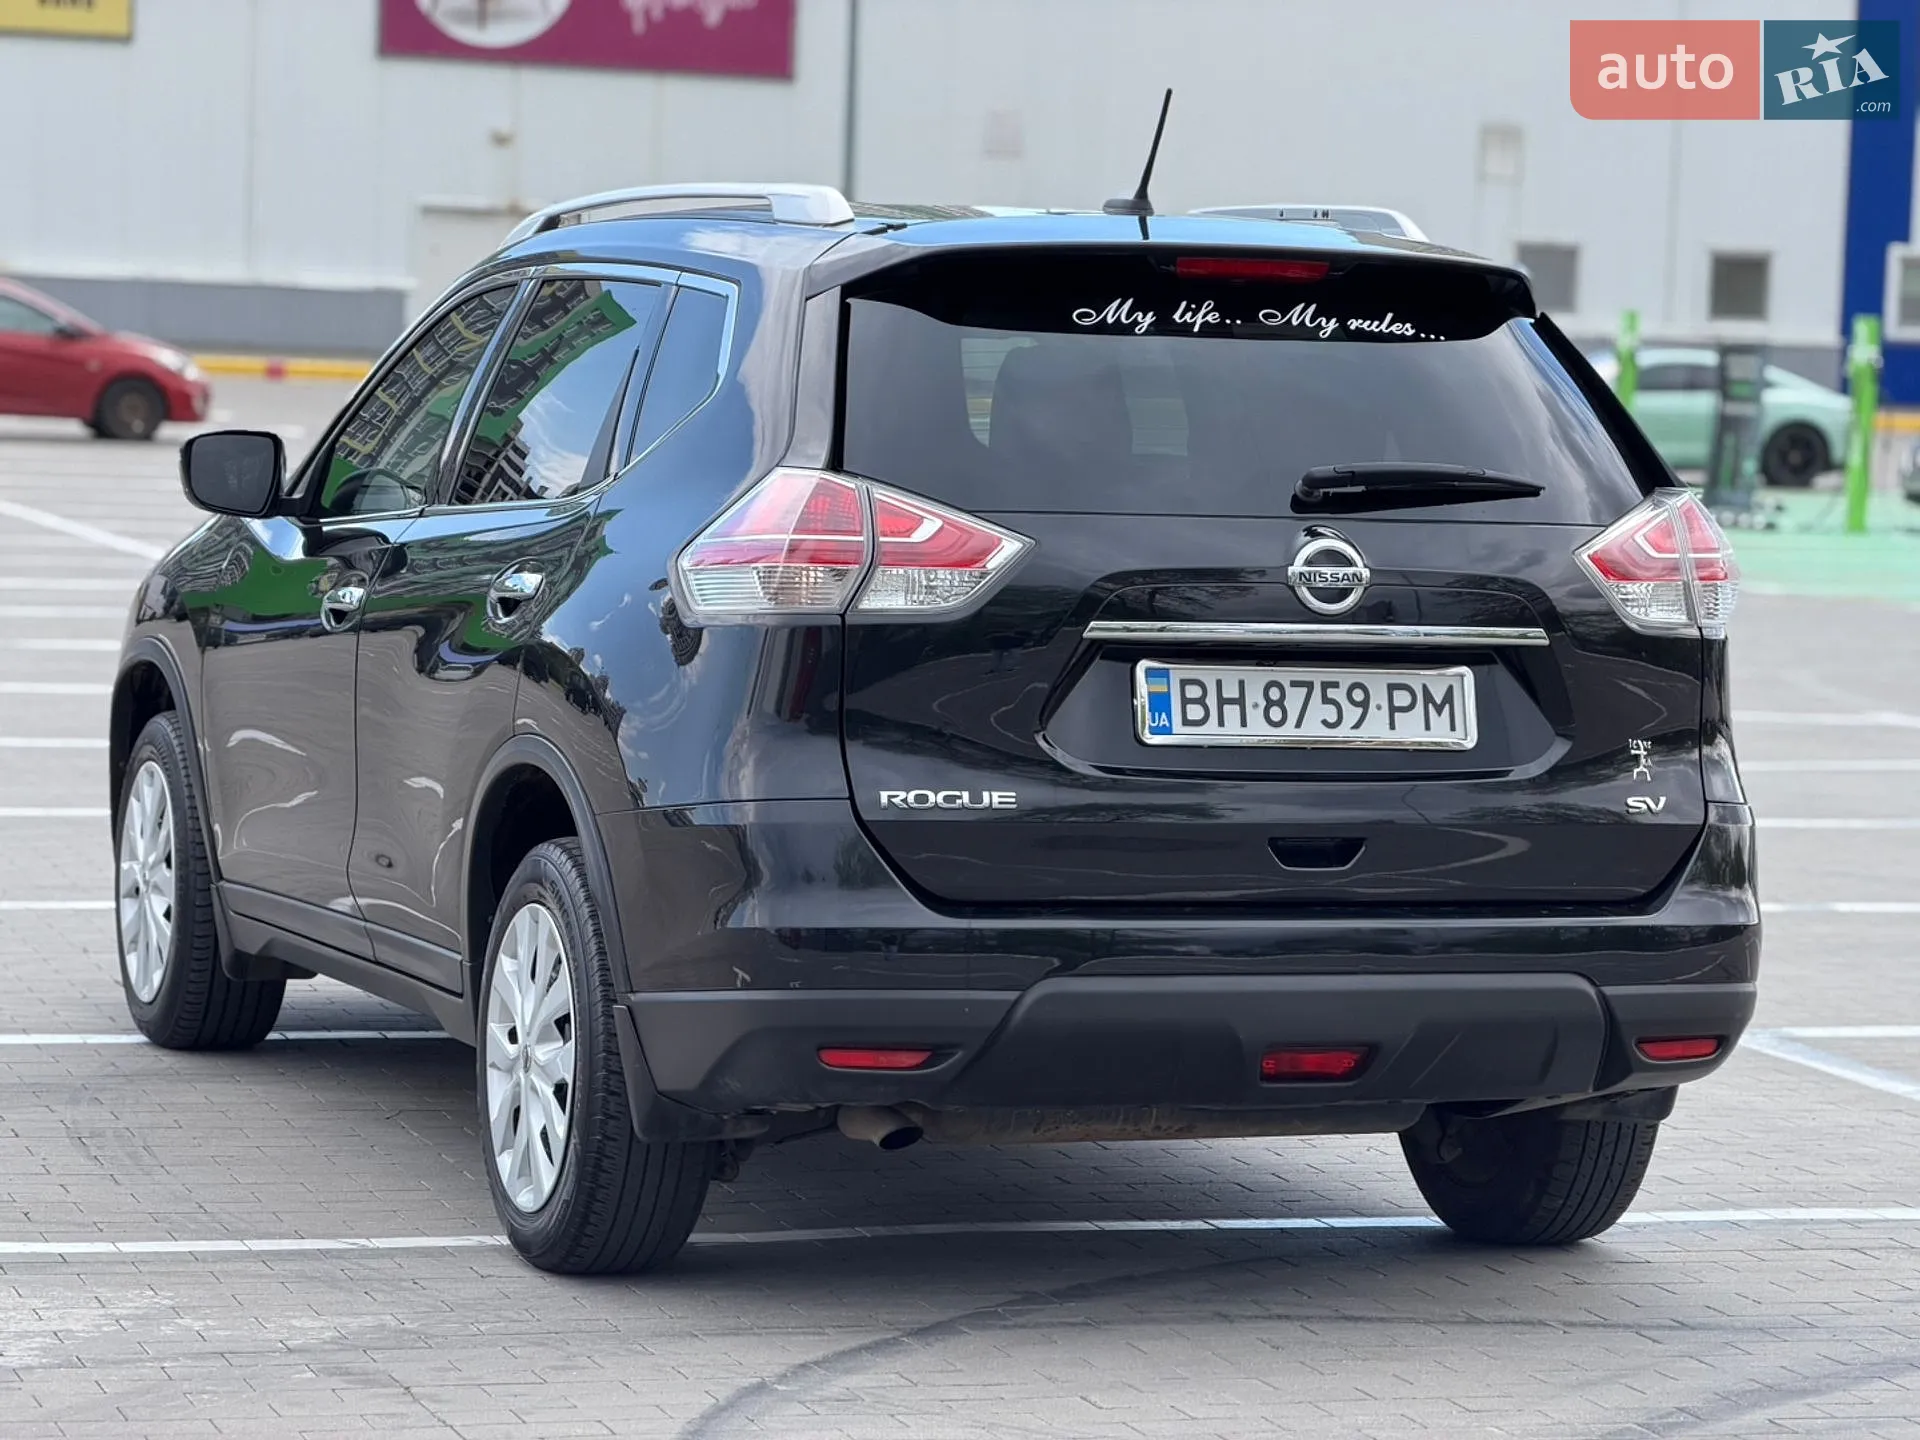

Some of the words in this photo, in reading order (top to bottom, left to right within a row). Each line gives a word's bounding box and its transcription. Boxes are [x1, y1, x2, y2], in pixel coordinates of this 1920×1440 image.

[1072, 297, 1156, 333] My
[1258, 302, 1339, 339] My
[1347, 312, 1446, 341] rules...
[1298, 571, 1363, 583] NISSAN
[1179, 678, 1247, 728] BH
[1263, 680, 1370, 730] 8759
[1386, 682, 1457, 732] PM
[1149, 712, 1169, 727] UA
[879, 789, 1018, 810] ROGUE
[1626, 796, 1667, 814] SV
